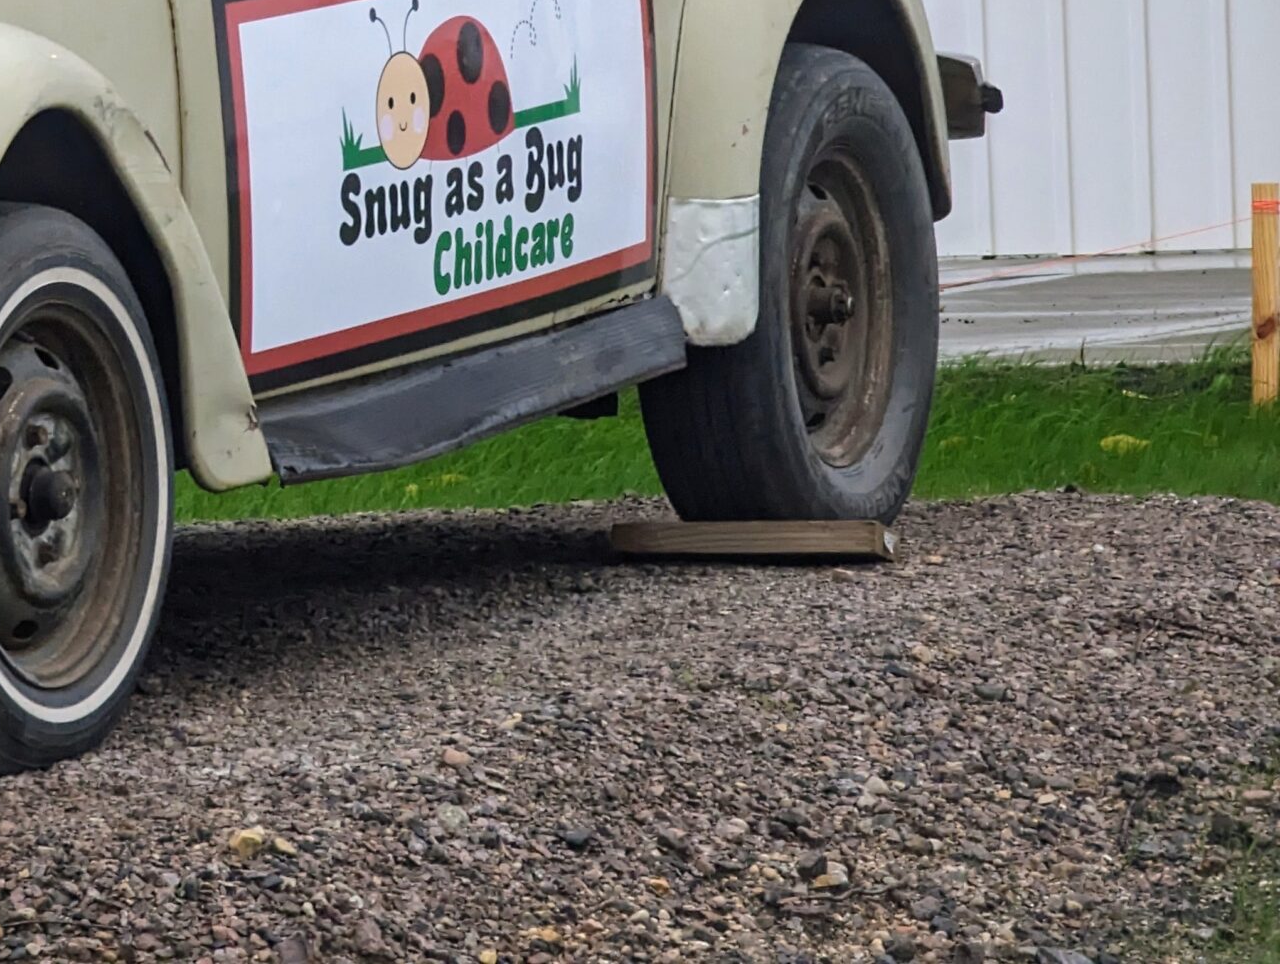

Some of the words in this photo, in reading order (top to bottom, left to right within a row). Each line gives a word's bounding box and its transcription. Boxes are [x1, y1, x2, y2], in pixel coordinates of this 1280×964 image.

[339, 172, 433, 246] Snug
[445, 161, 484, 218] as
[496, 154, 514, 204] a
[524, 126, 582, 213] Bug
[433, 212, 574, 295] Childcare
